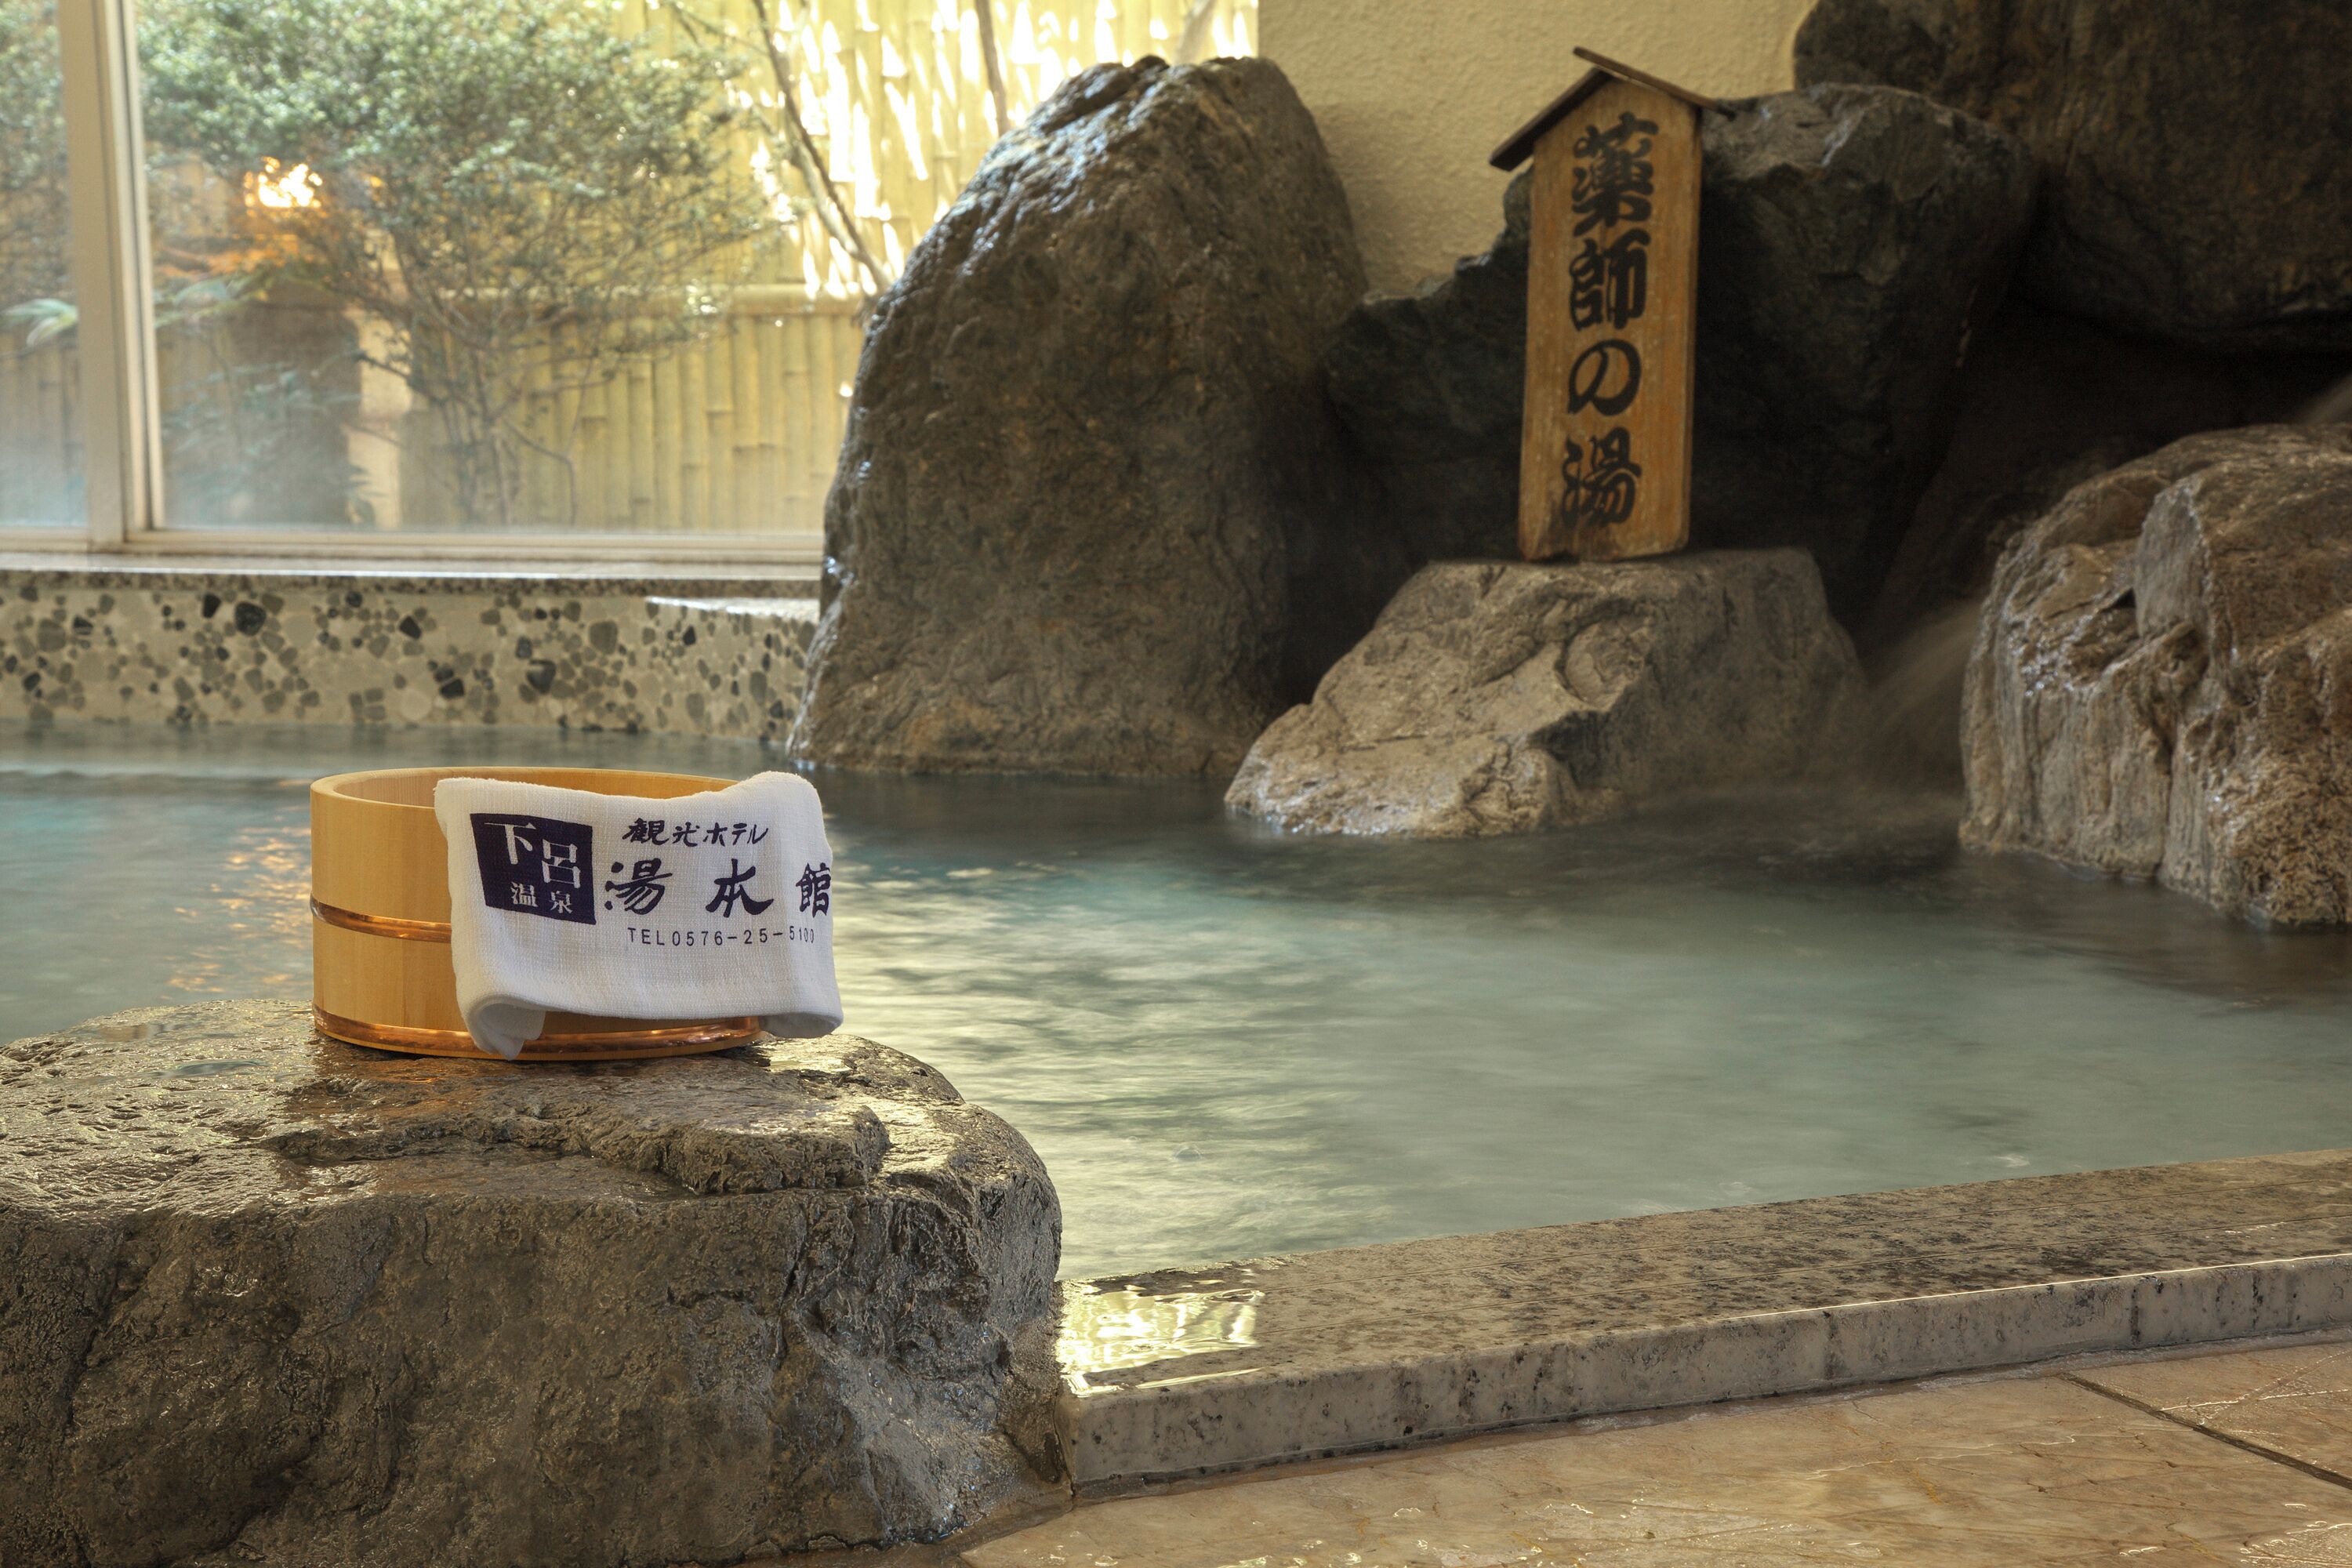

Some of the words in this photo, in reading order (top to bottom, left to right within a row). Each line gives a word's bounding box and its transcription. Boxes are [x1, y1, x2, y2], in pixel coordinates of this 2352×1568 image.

[484, 822, 581, 889] 下呂
[622, 818, 769, 847] 観光ホテル
[510, 880, 574, 914] 温泉
[604, 858, 832, 918] 湯本館
